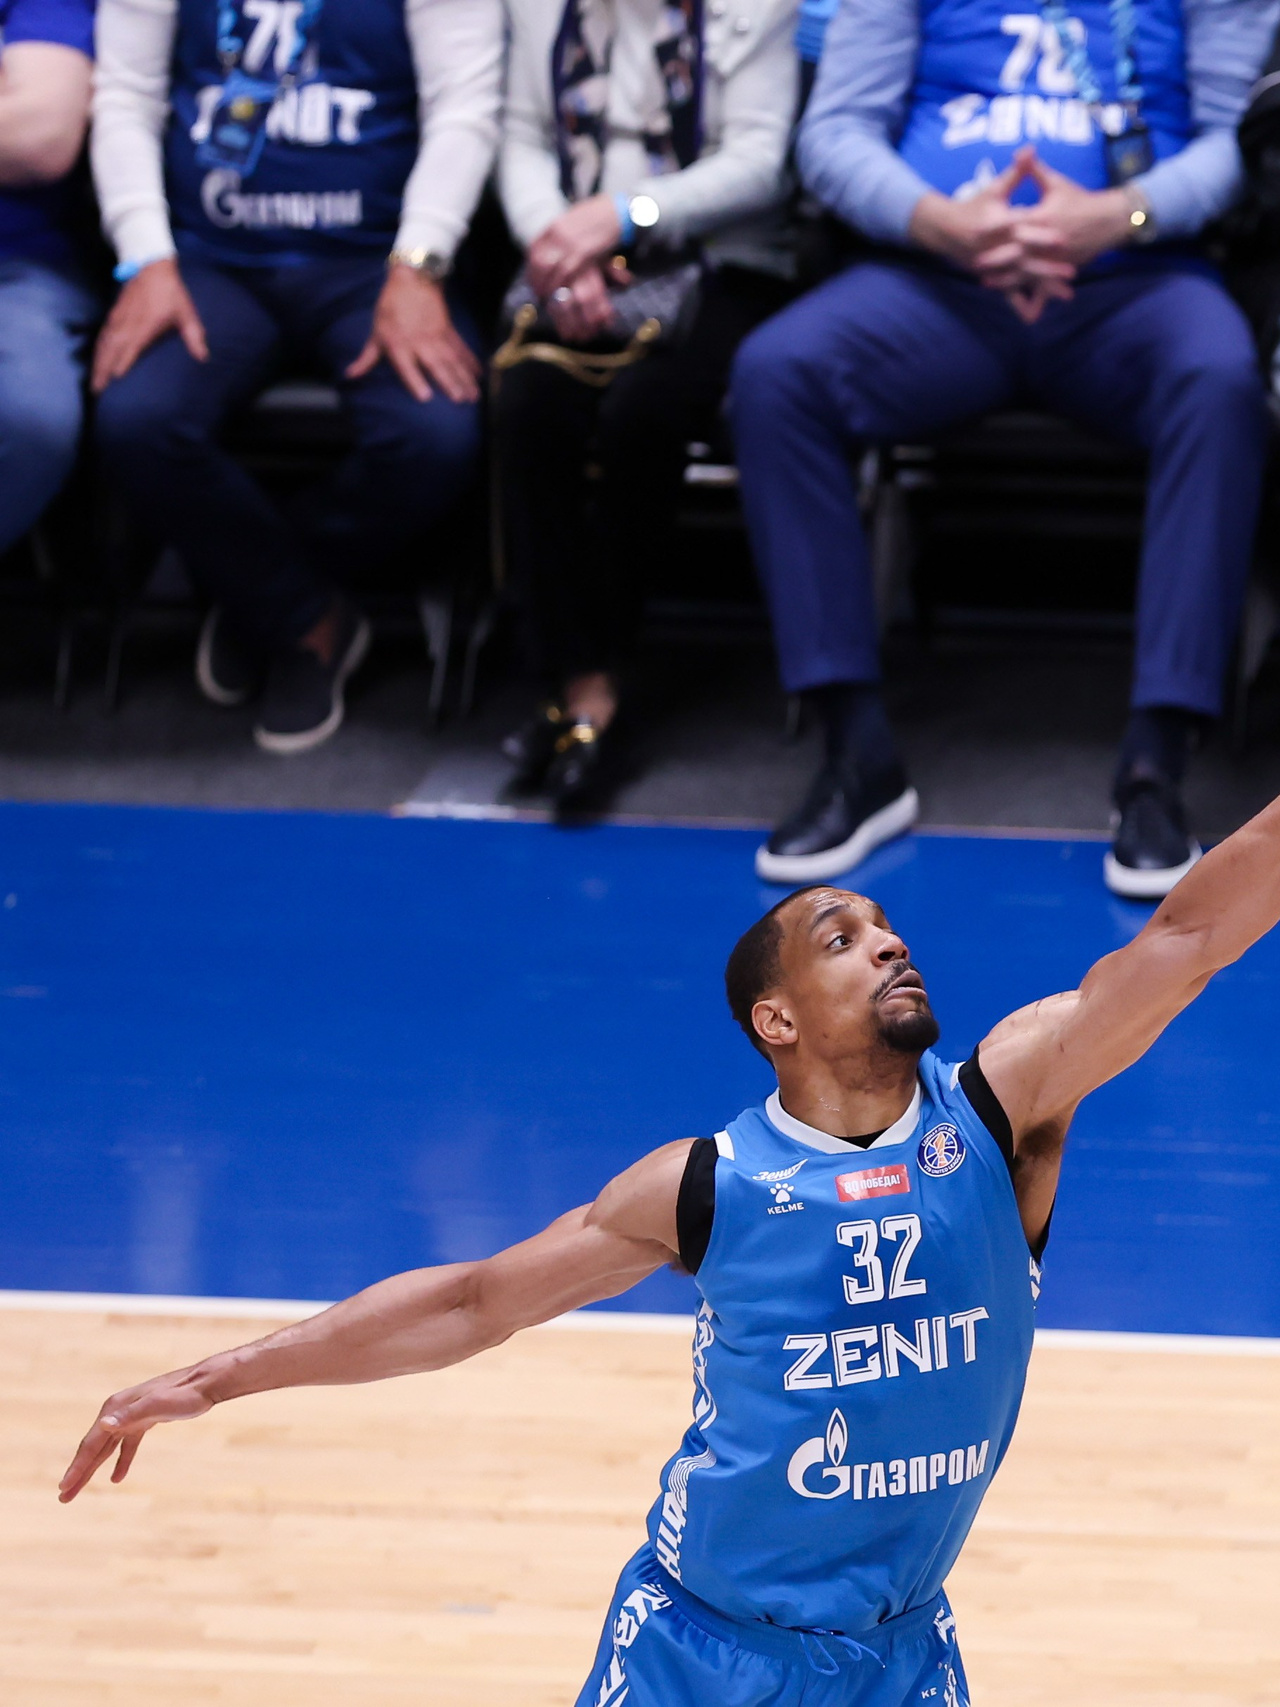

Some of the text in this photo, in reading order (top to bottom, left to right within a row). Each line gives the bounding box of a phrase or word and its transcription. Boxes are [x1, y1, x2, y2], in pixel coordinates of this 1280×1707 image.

[767, 1202, 805, 1215] KELME
[860, 1174, 901, 1190] ПОБЕДА!
[836, 1213, 927, 1305] 32
[782, 1306, 990, 1391] ZENIT
[853, 1439, 990, 1500] ГАЗПРОМ
